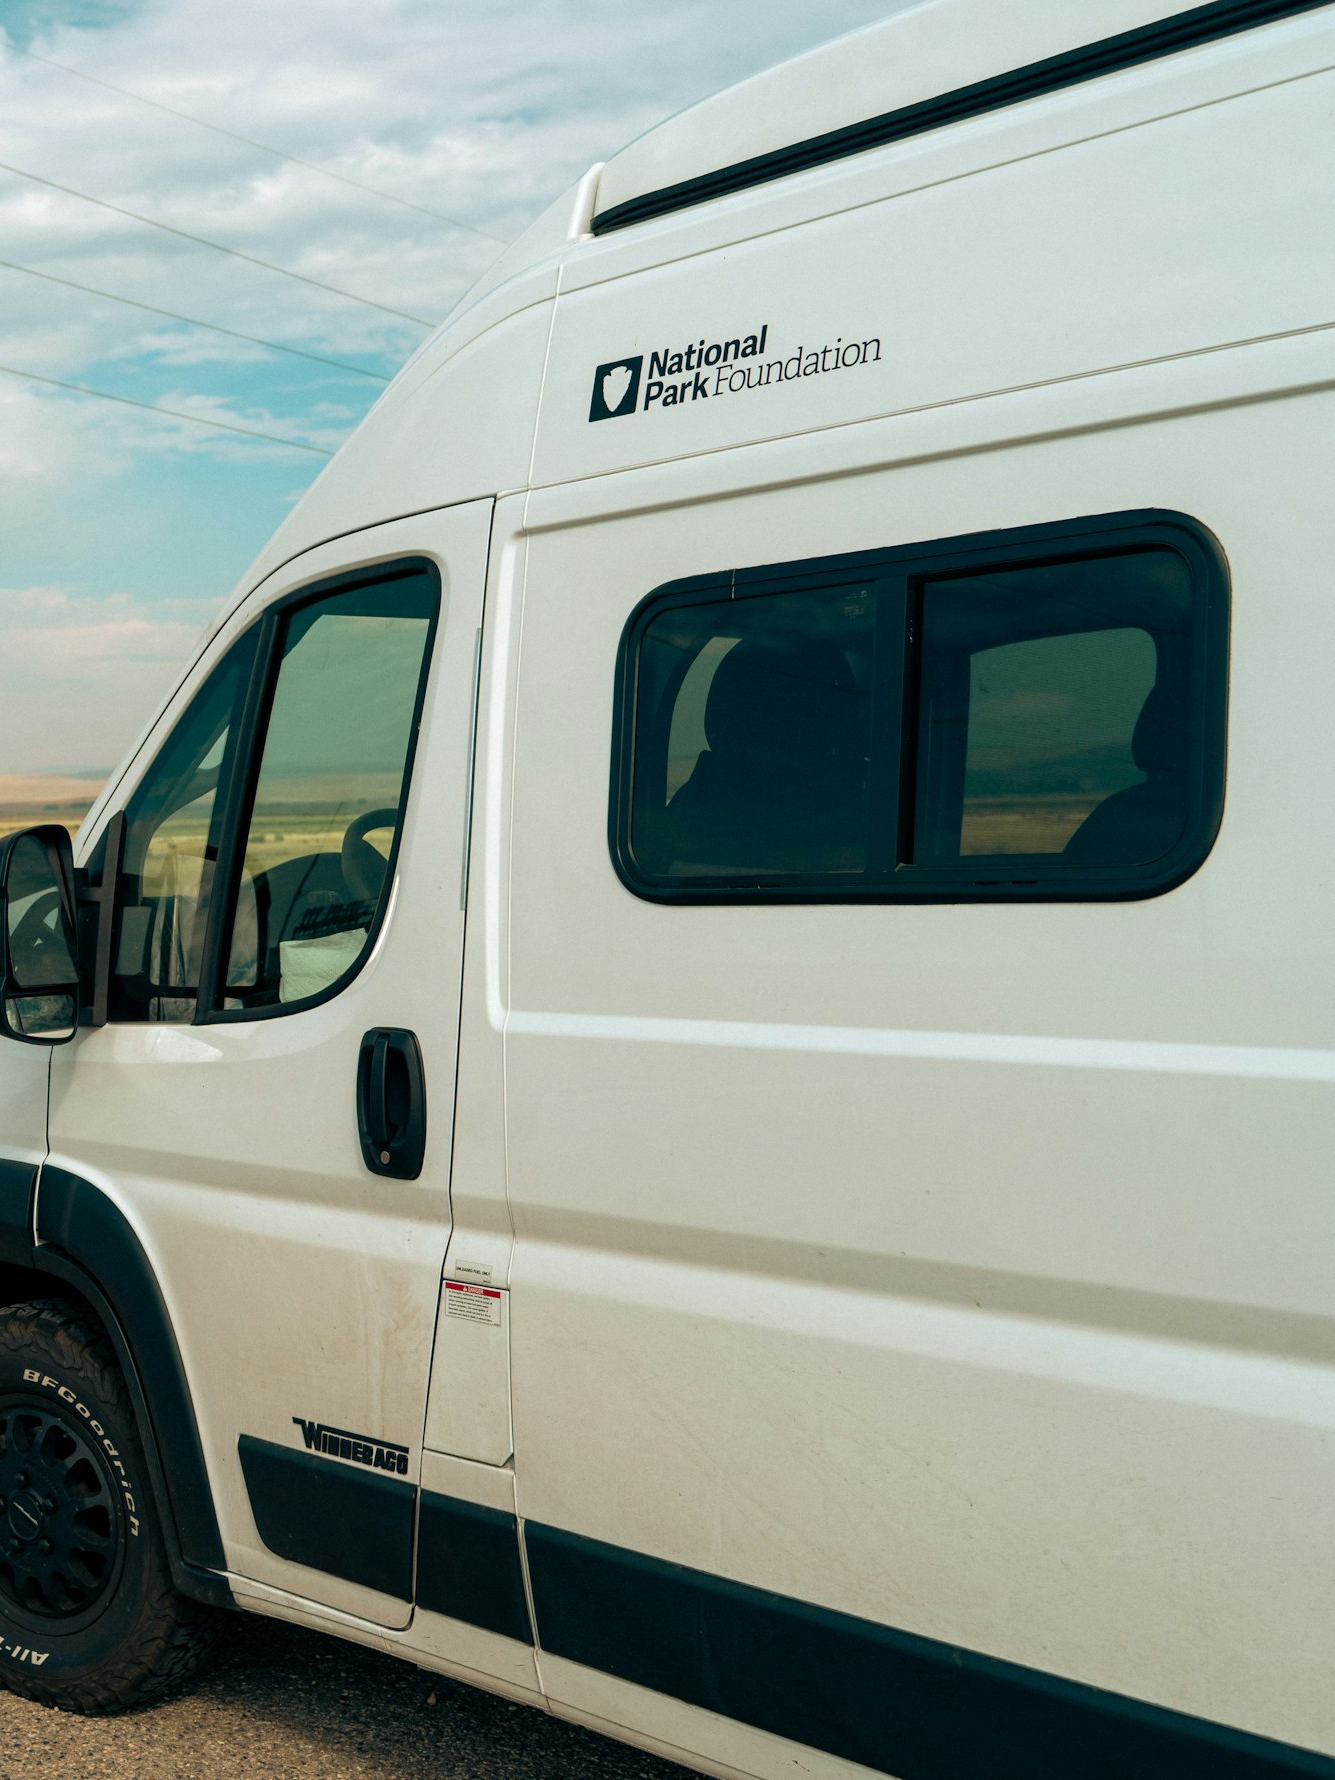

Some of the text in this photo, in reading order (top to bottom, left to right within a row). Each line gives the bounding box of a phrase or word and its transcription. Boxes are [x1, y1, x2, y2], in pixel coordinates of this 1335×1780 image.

[643, 337, 882, 411] Park Foundation
[647, 324, 768, 379] National
[467, 1286, 484, 1295] DANGER
[22, 1368, 140, 1537] BFGoodrich
